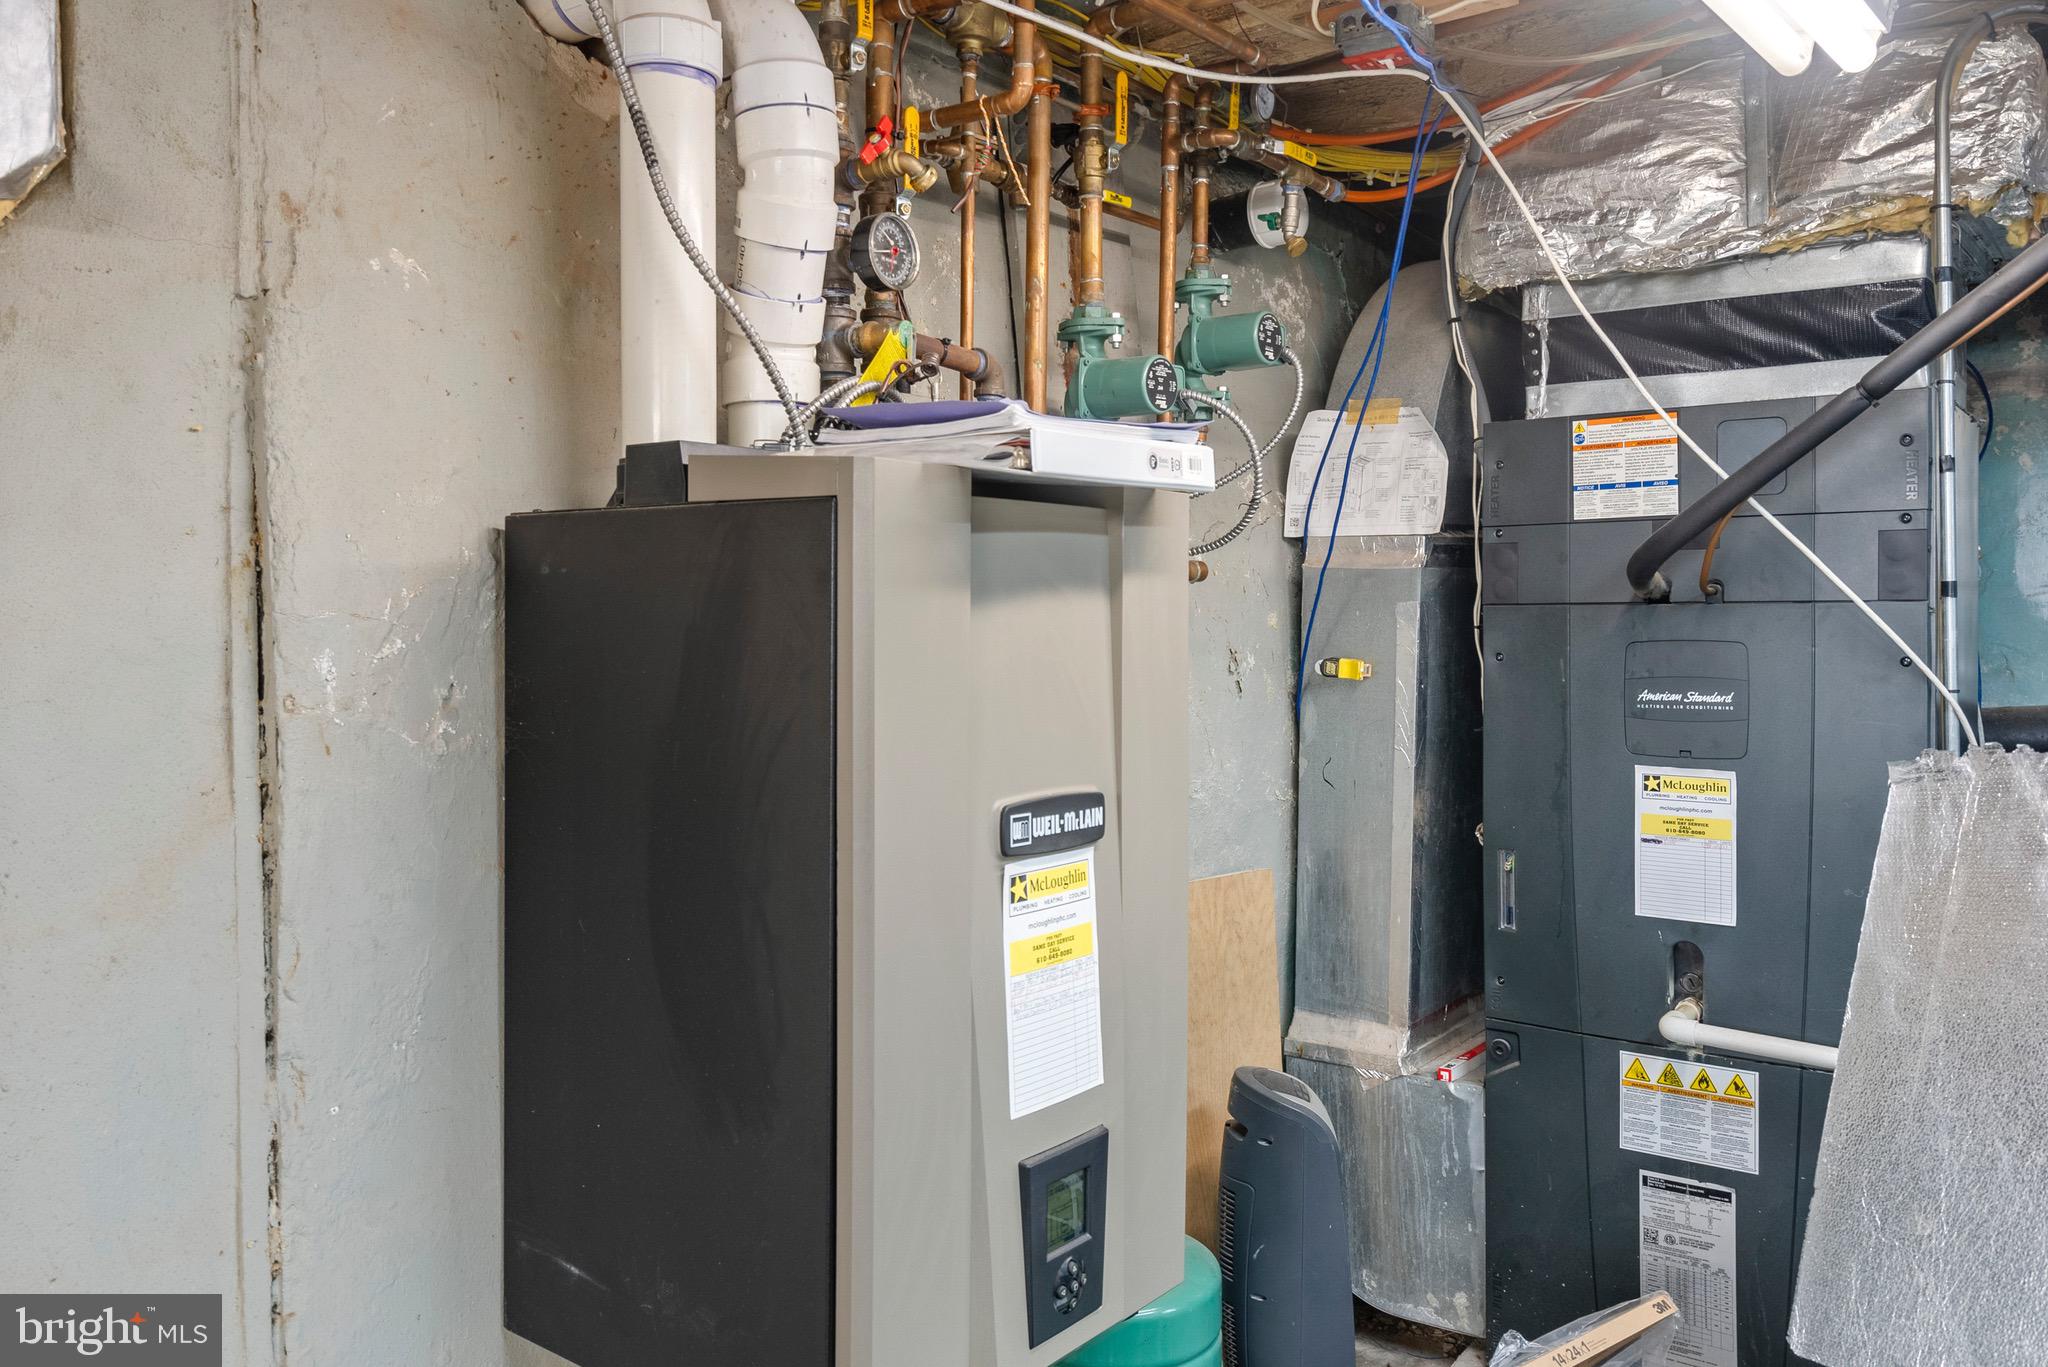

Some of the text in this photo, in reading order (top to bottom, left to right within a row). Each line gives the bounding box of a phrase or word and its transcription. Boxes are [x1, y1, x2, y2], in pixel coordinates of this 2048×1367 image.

[736, 246, 745, 287] SCH 40
[1905, 450, 1919, 500] HEATER
[1490, 476, 1500, 518] HEATER
[1637, 689, 1734, 703] American Standard
[1663, 780, 1726, 793] McLoughlin
[1029, 869, 1086, 893] McLoughlin
[1013, 890, 1087, 912] PLUMBING HEATING COOLING
[1057, 935, 1075, 945] SERVICE
[1667, 1088, 1707, 1099] AVERTISSEMENT
[1718, 1097, 1753, 1107] ADVERTENCIA
[1652, 1299, 1672, 1314] 3M
[1552, 1341, 1590, 1367] 14x24x1
